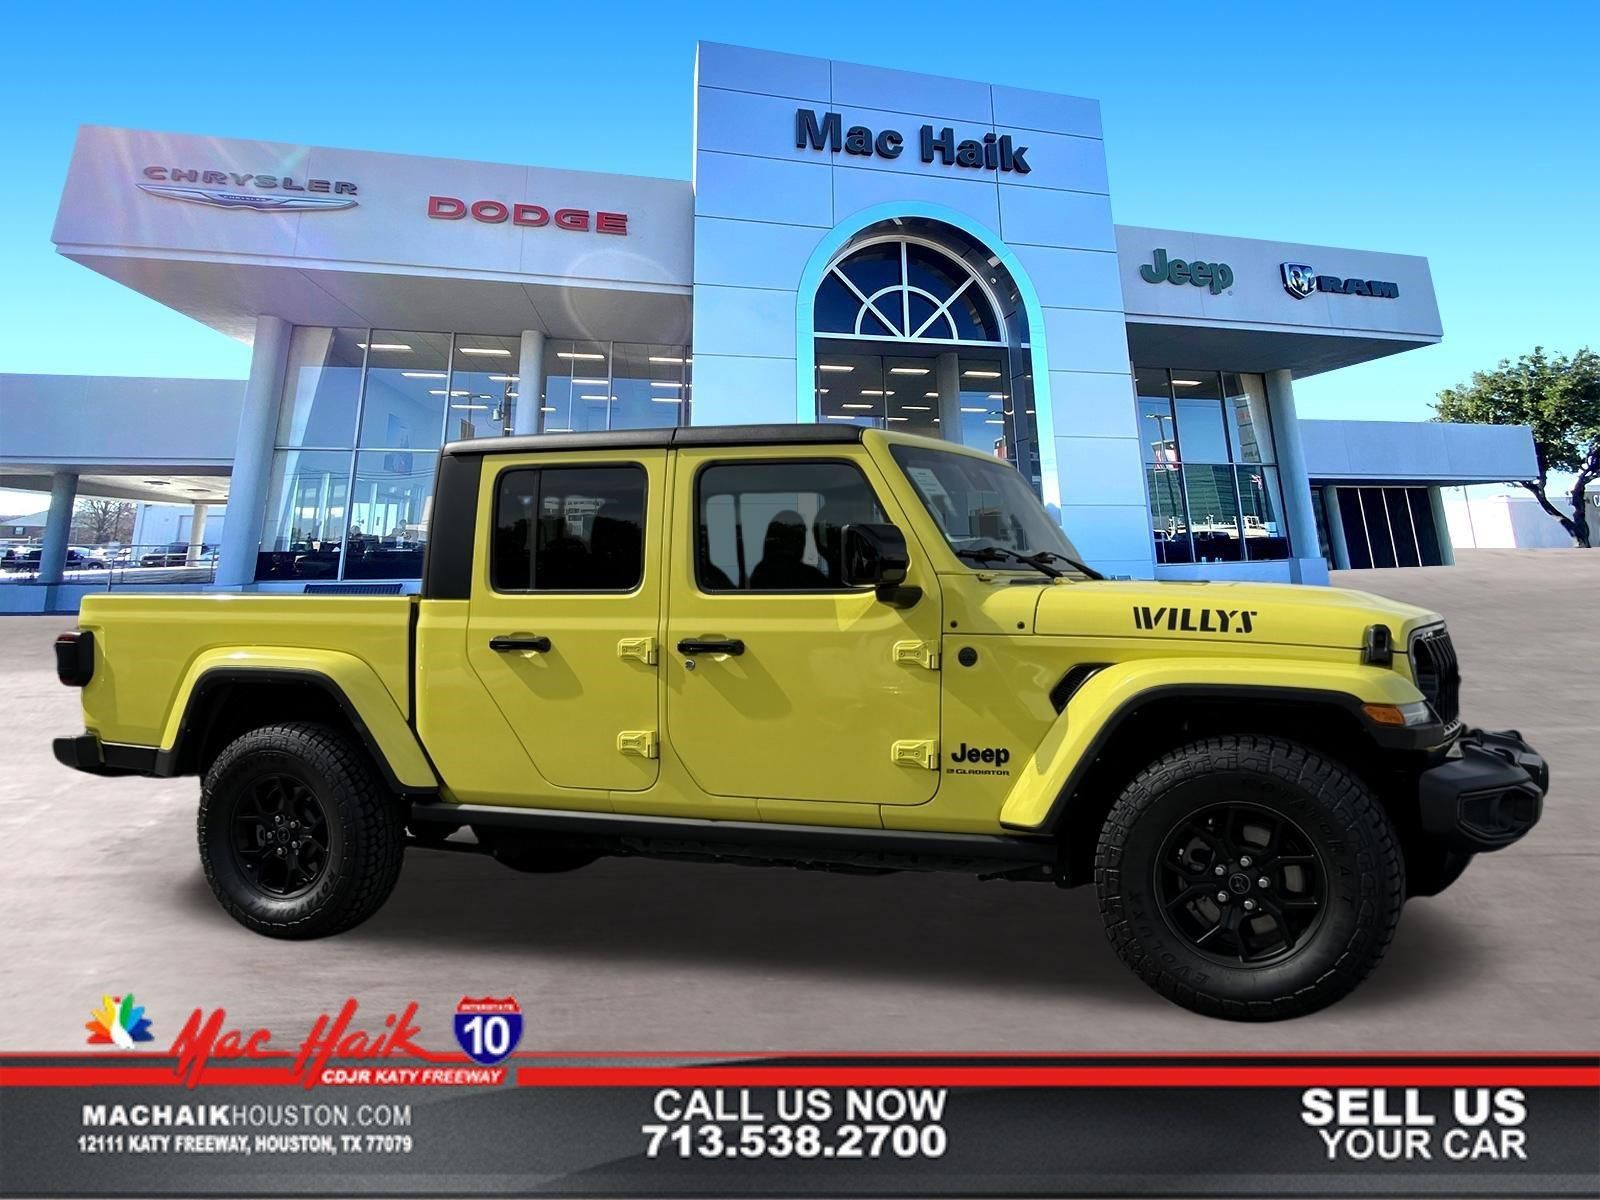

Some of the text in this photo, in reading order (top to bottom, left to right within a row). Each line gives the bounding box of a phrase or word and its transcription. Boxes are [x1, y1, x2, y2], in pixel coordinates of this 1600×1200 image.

[795, 108, 1032, 174] Mac Haik
[143, 166, 359, 196] CHRYSLER
[428, 195, 628, 236] DODGE
[1140, 248, 1234, 295] Jeep
[1315, 275, 1400, 299] RAM
[1133, 606, 1258, 634] WILLYS
[951, 742, 1010, 767] Jeep
[956, 768, 1010, 776] GLADIATOR
